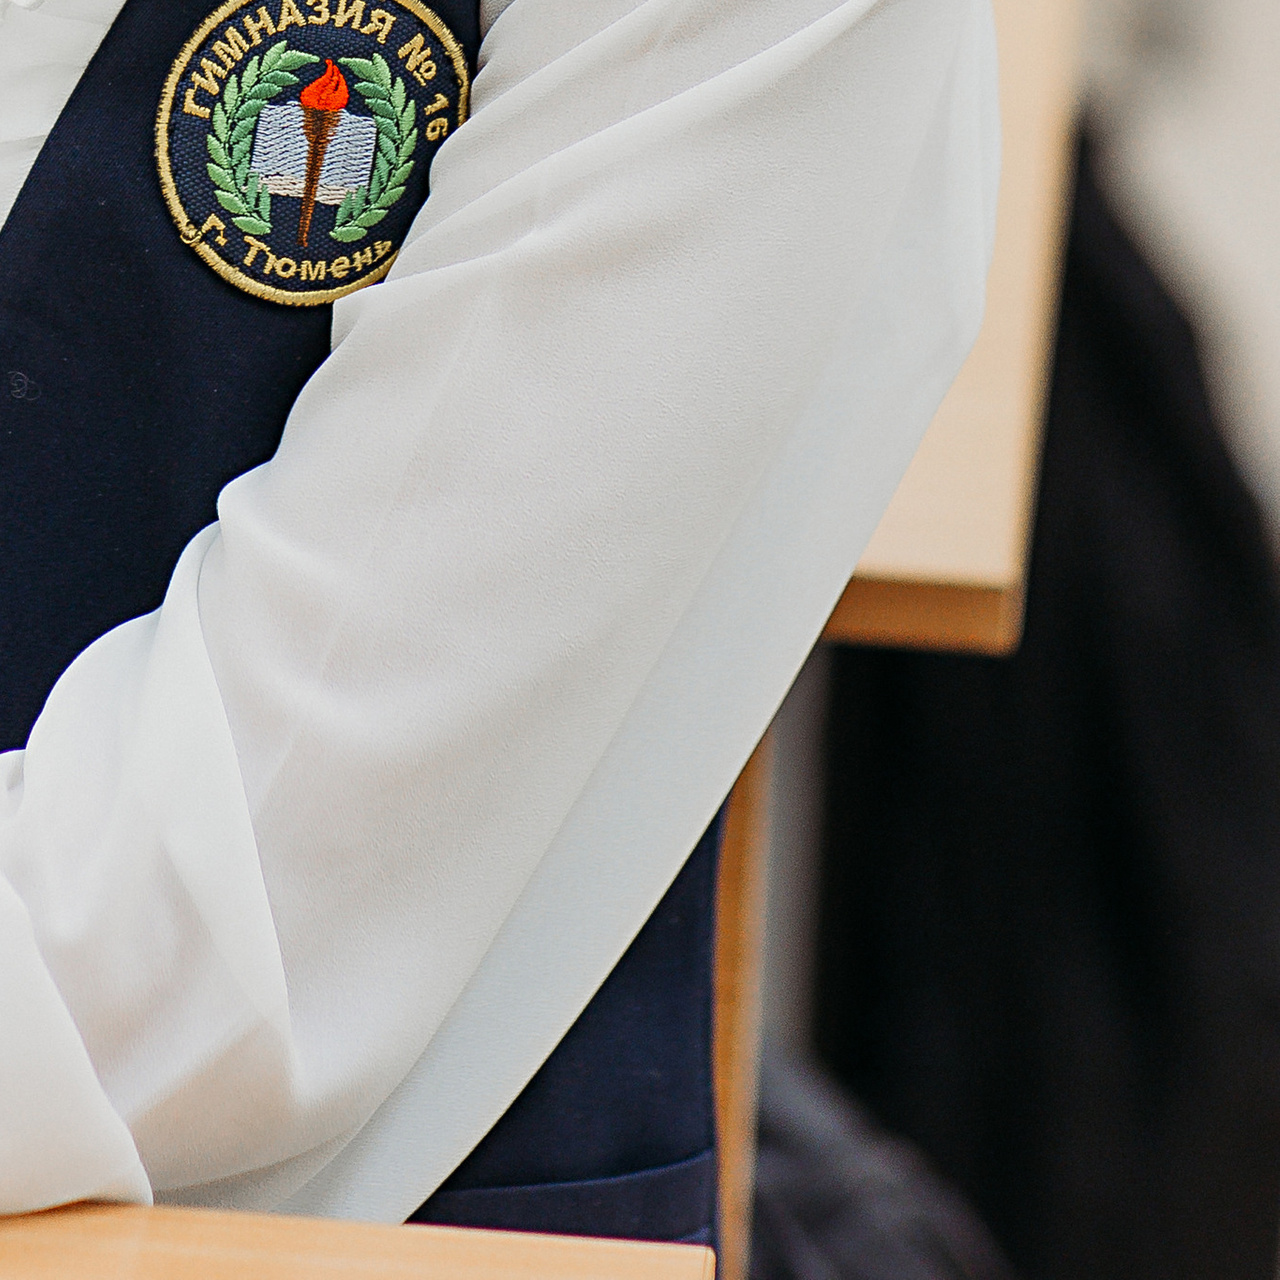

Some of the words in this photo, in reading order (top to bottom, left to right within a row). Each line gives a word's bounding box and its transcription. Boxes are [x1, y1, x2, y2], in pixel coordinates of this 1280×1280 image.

[398, 32, 437, 86] №
[424, 93, 449, 141] 16
[243, 235, 393, 281] Тюмень
